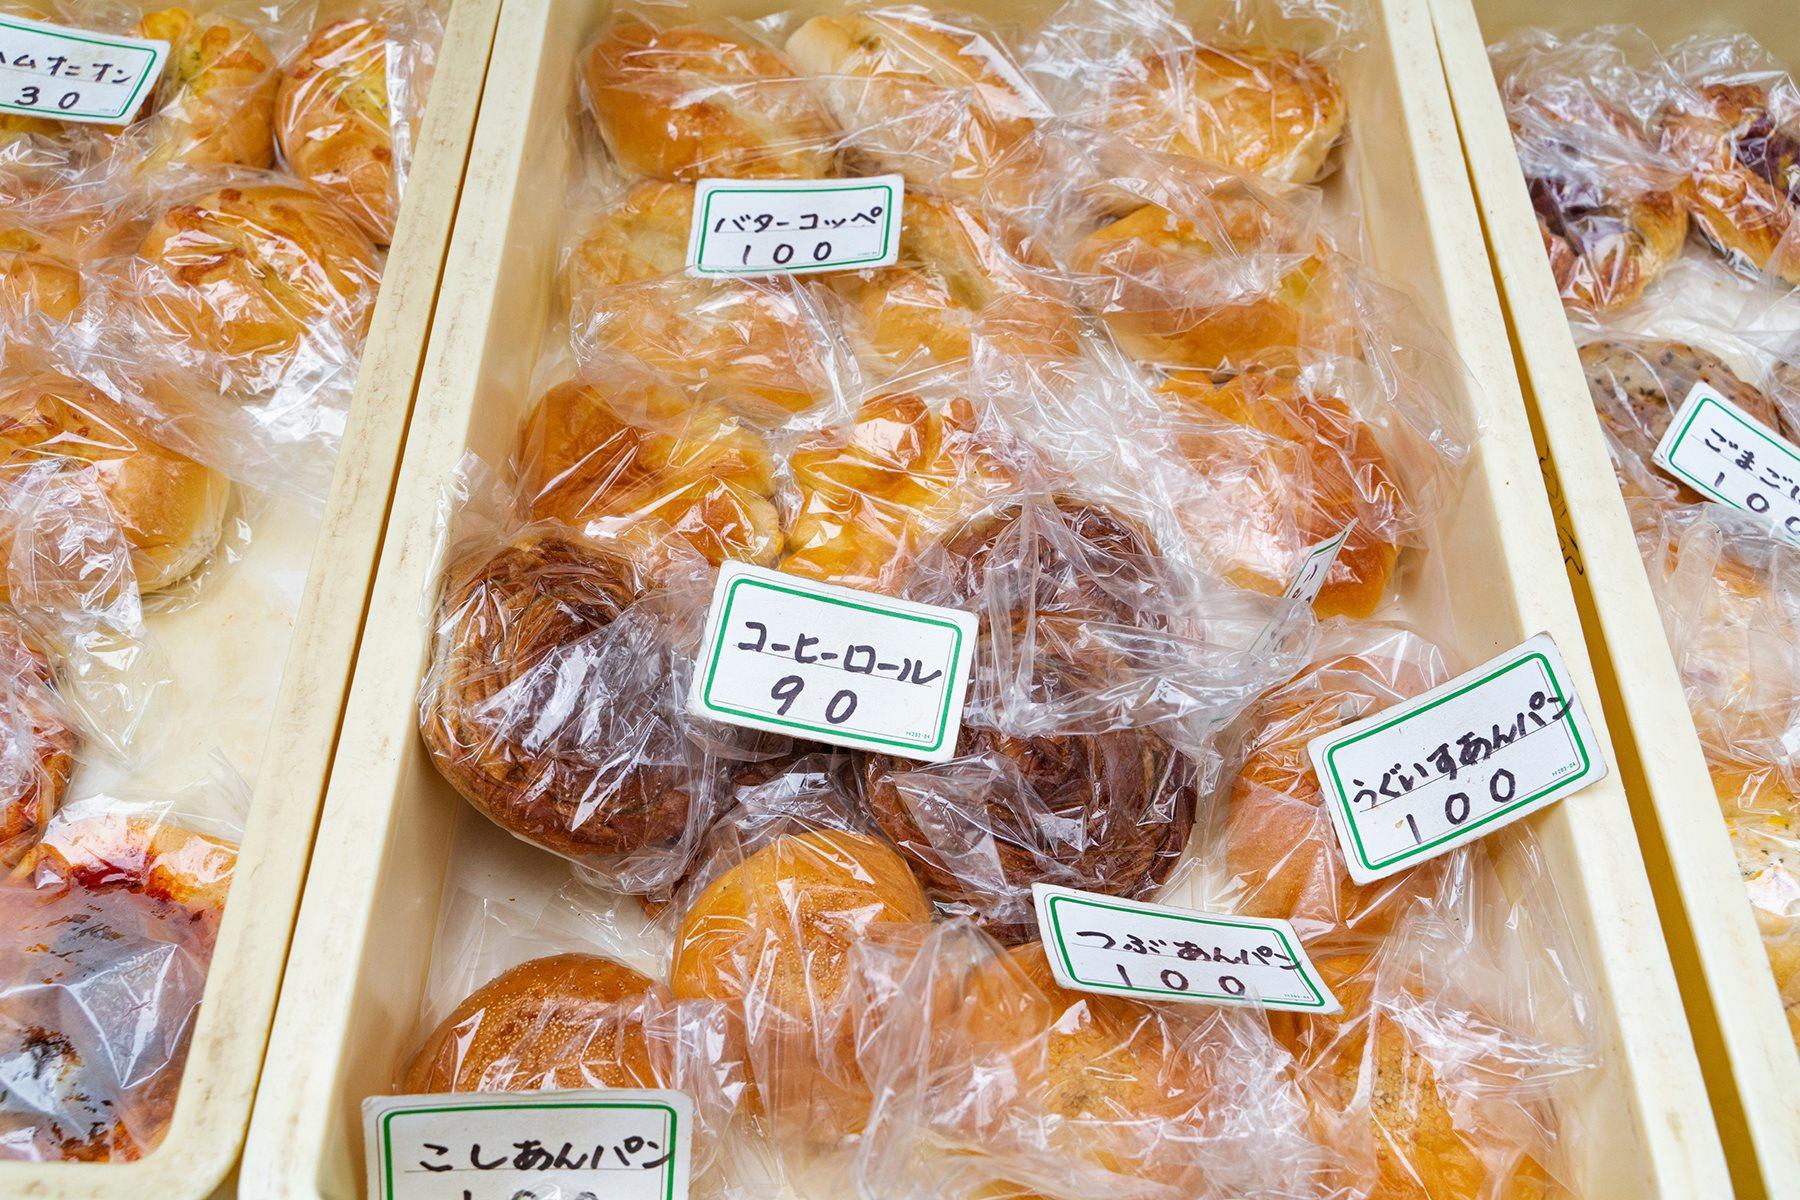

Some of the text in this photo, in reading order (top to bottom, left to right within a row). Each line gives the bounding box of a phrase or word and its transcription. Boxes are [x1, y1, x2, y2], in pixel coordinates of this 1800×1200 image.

[714, 206, 883, 233] バターコッペ
[742, 241, 832, 265] 100
[738, 621, 943, 684] コーヒーロール
[771, 675, 858, 724] 90
[1353, 691, 1574, 809] うぐいすあんパン
[1406, 768, 1516, 844] 100
[1076, 931, 1303, 970] つぶあんパン
[1116, 963, 1246, 996] 100
[419, 1135, 672, 1172] こしあんパン
